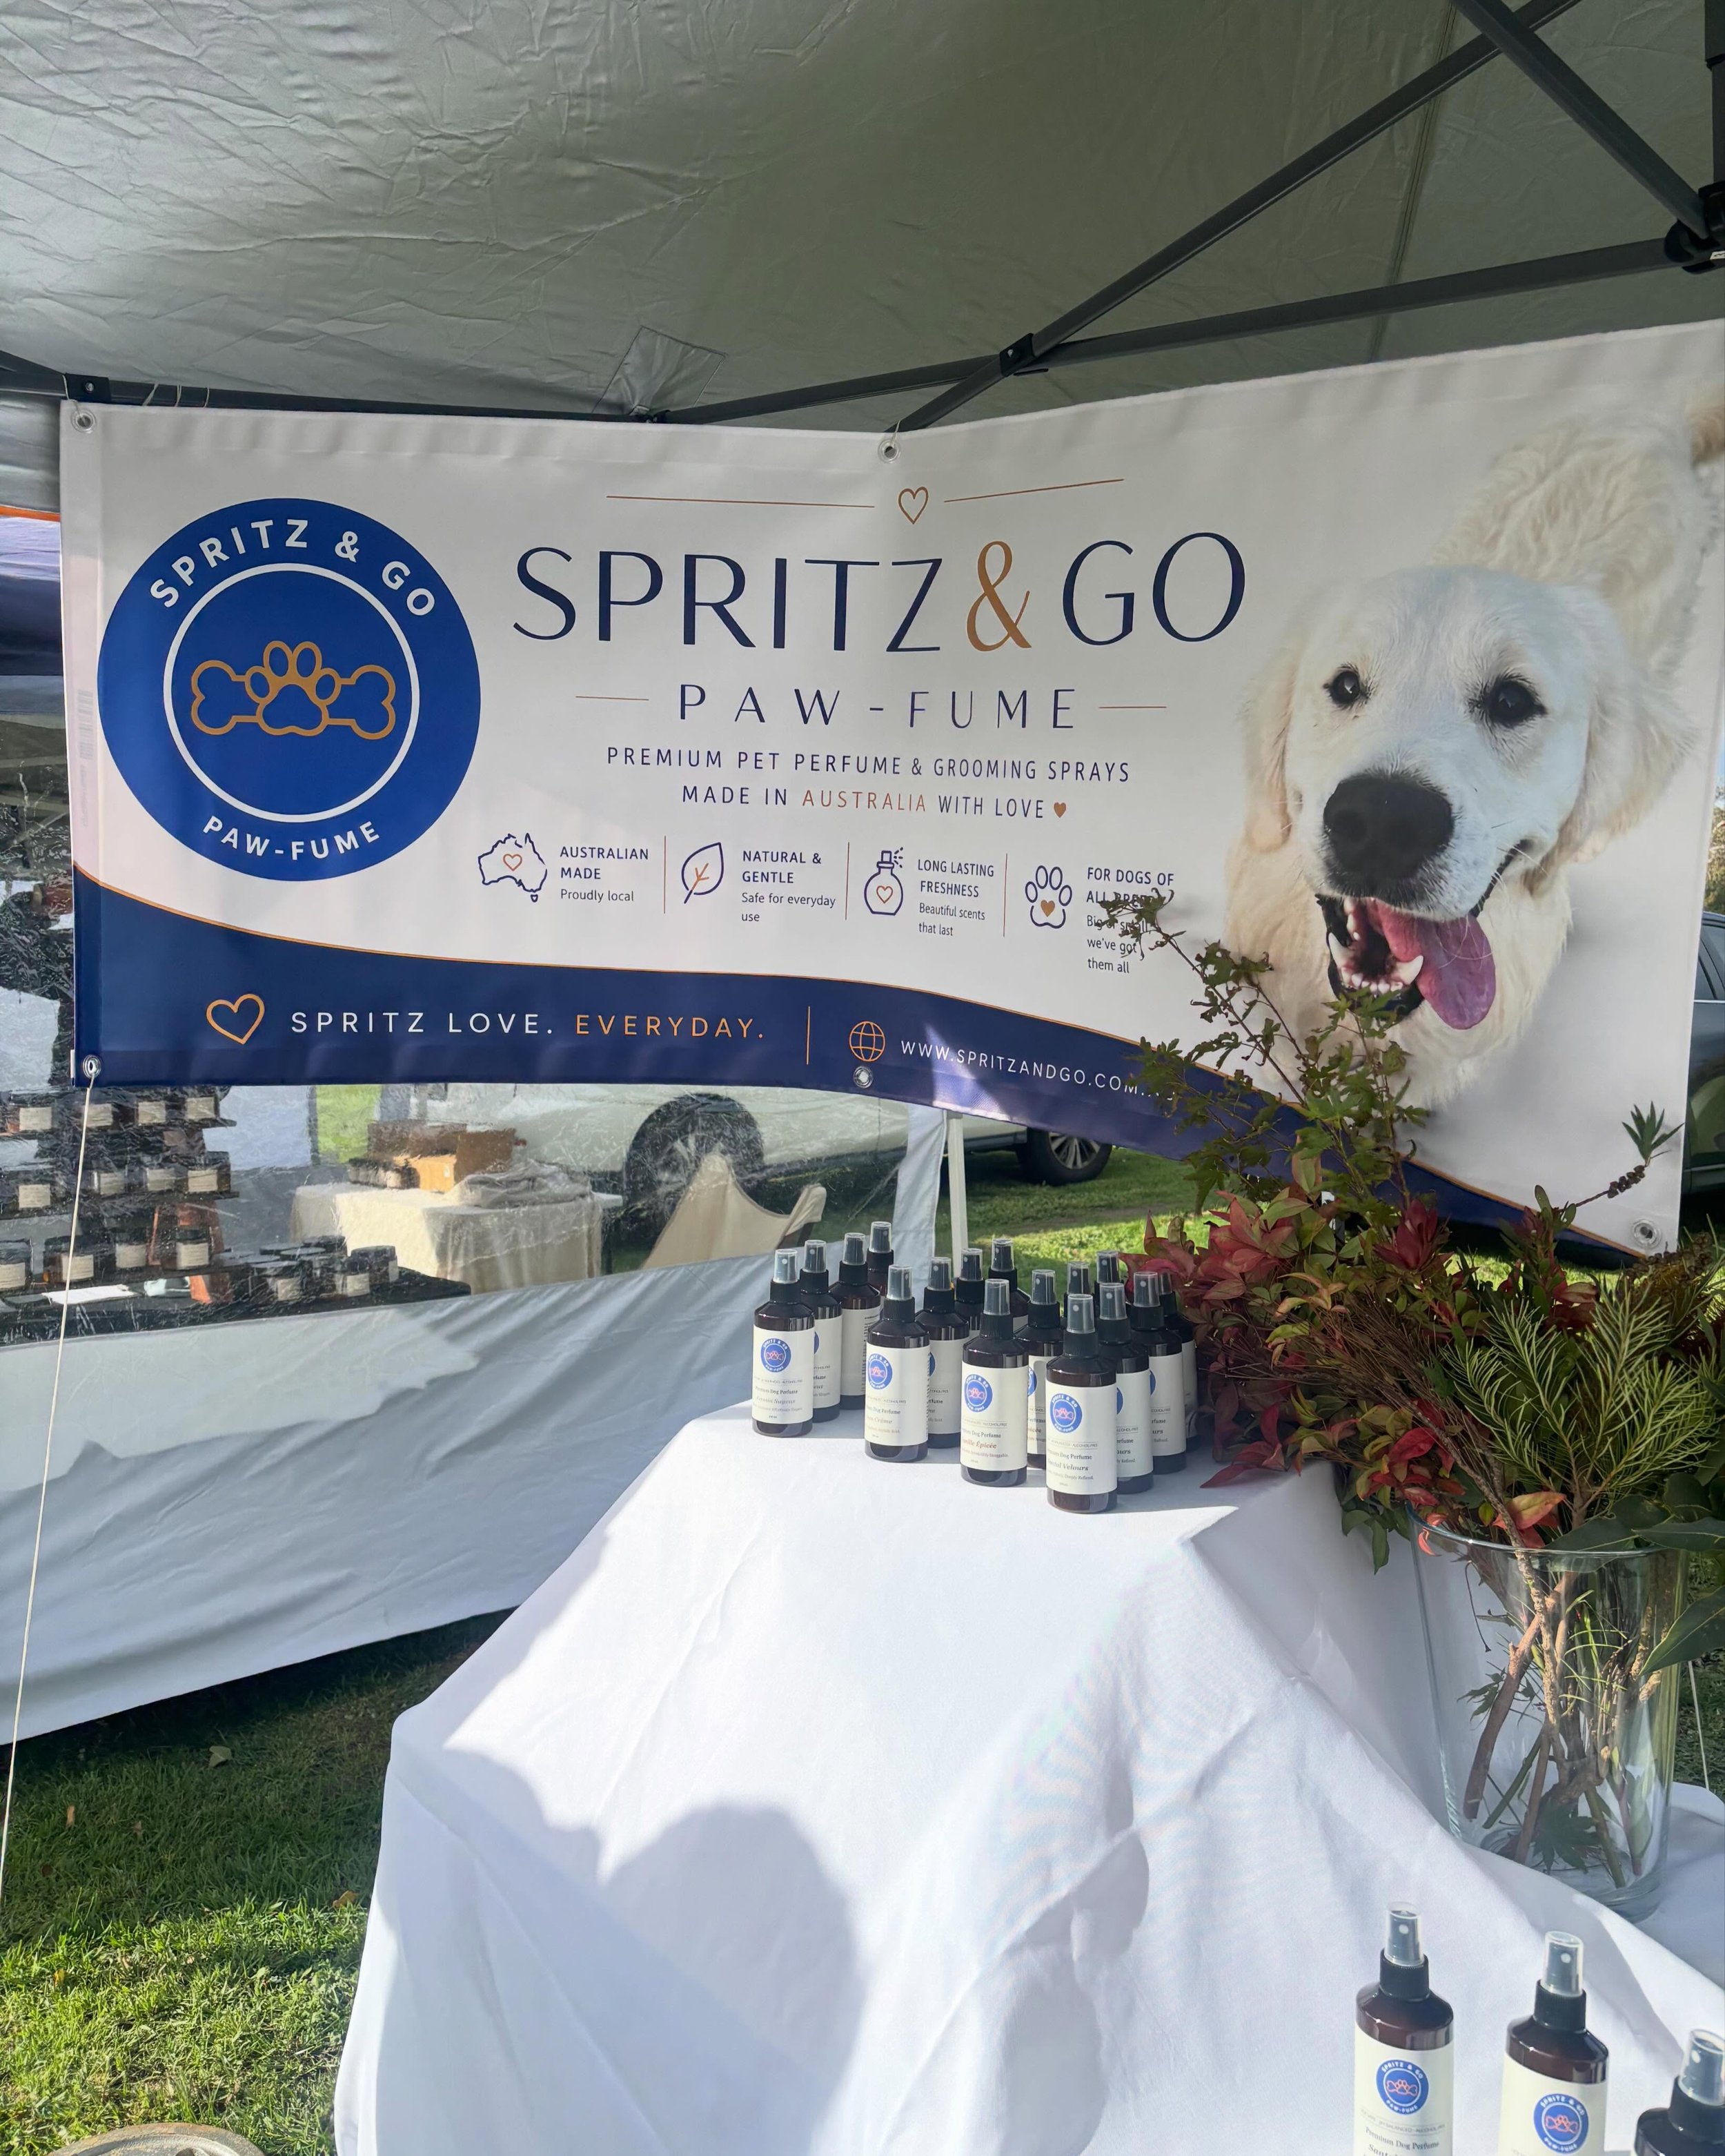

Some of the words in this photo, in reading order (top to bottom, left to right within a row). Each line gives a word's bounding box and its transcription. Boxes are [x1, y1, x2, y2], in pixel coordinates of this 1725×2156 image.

[150, 518, 308, 608] SPRITZ
[334, 531, 360, 562] &
[382, 560, 435, 616] GO
[607, 747, 721, 768] PREMIUM
[738, 752, 780, 770] PET
[794, 754, 900, 775] PERFUME
[911, 758, 922, 775] &
[934, 758, 1036, 779] GROOMING
[1048, 761, 1129, 782] SPRAYS
[682, 785, 749, 805] MADE
[765, 788, 787, 805] IN
[802, 790, 926, 812] AUSTRALIA
[938, 795, 983, 816] WITH
[995, 798, 1044, 819] LOVE
[202, 815, 380, 861] PAW-FUME
[560, 846, 649, 860] AUSTRALIAN
[742, 850, 806, 863] NATURAL
[812, 852, 822, 864] &
[560, 867, 602, 879] MADE
[918, 859, 947, 872] LONG
[951, 862, 994, 877] LASTING
[1087, 867, 1110, 881] FOR
[1116, 869, 1152, 885] DOGS
[1157, 872, 1174, 886] OF
[742, 871, 793, 883] GENTLE
[560, 888, 604, 903] Proudly
[608, 890, 634, 901] local
[920, 880, 979, 898] FRESHNESS
[742, 892, 765, 903] Safe
[769, 892, 784, 903] for
[787, 894, 836, 909] everyday
[742, 913, 760, 922] use
[919, 902, 956, 917] Beautiful
[959, 909, 985, 921] scents
[918, 921, 936, 934] that
[939, 923, 953, 937] last
[1087, 937, 1116, 951] we've
[1119, 941, 1138, 955] got
[1087, 957, 1114, 972] them
[1117, 961, 1130, 974] all
[291, 1012, 424, 1033] SPRITZ
[448, 1012, 553, 1034] LOVE.
[575, 1015, 763, 1039] EVERYDAY.
[1395, 2139, 1410, 2150] Dog
[1412, 2142, 1440, 2150] Perfume
